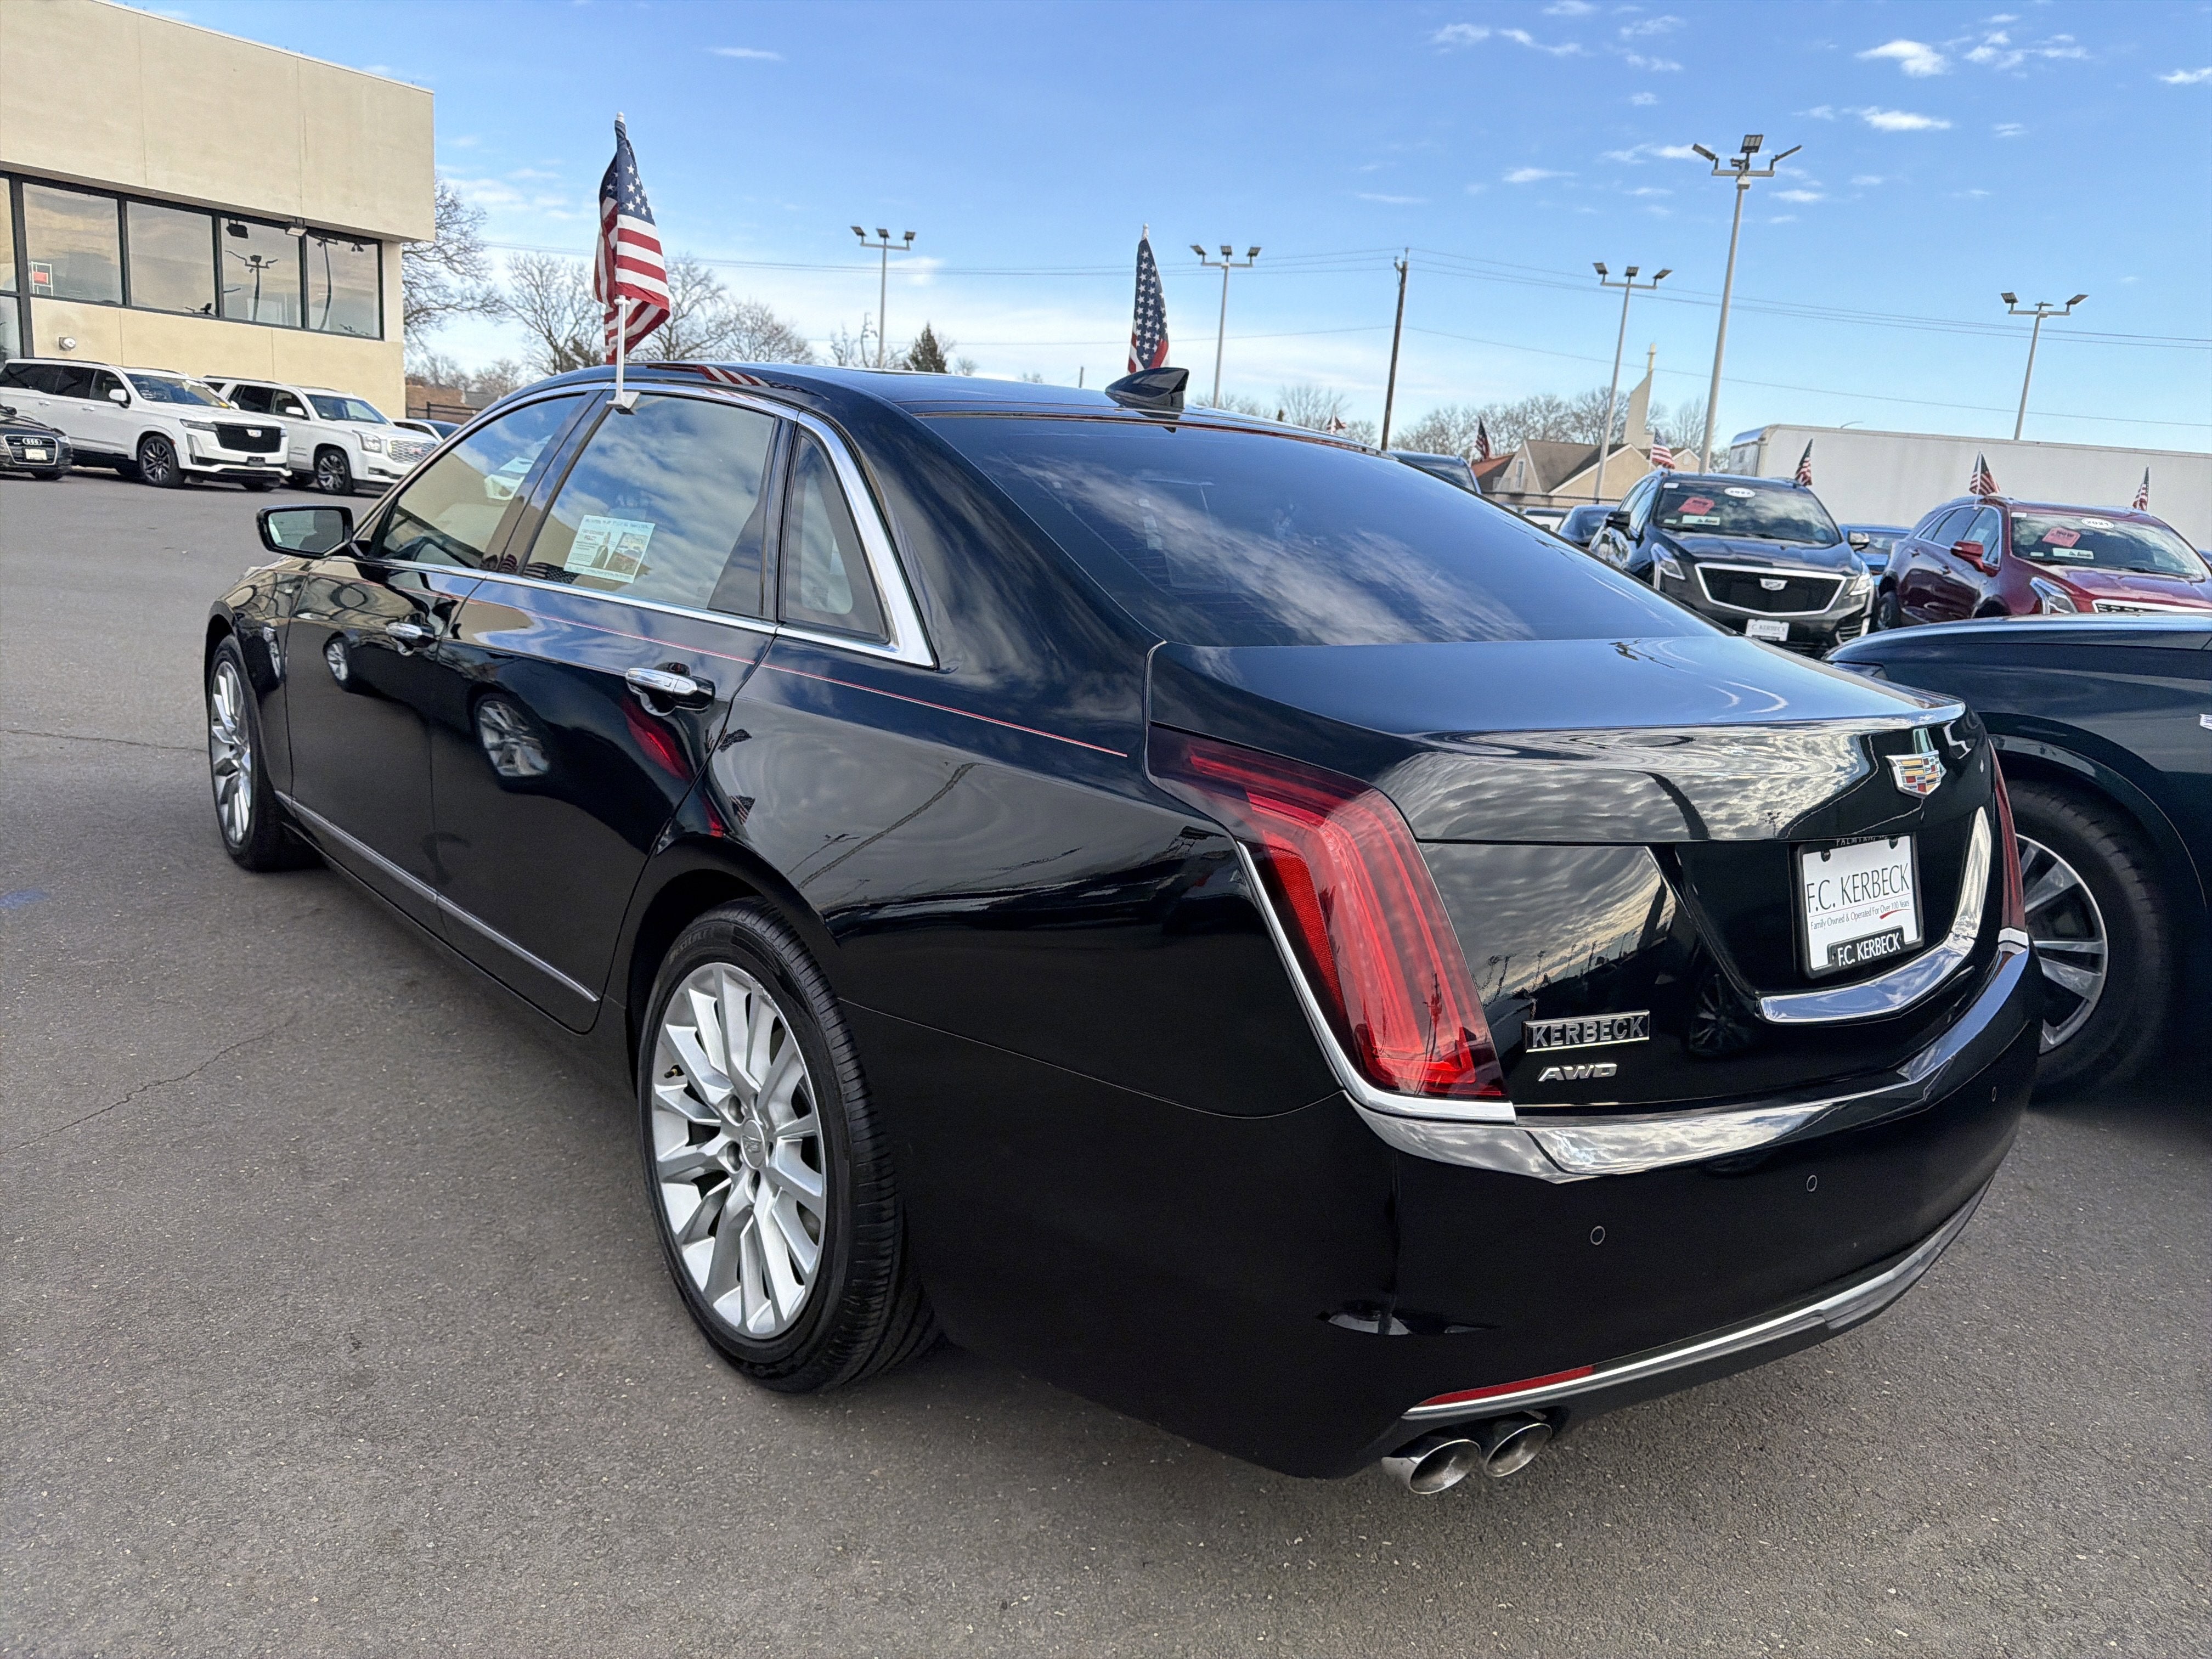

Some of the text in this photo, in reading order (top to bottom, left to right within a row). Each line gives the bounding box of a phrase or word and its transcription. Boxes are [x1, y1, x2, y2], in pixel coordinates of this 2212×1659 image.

[1806, 862, 1910, 913] F.C. KERBECK
[1810, 918, 1826, 930] Family
[1827, 914, 1844, 927] Owned
[1846, 913, 1849, 922] &
[1850, 907, 1871, 922] Operated
[1880, 904, 1891, 913] Over
[1899, 900, 1910, 908] Years
[1837, 932, 1900, 967] F.C. KERBECK
[1532, 1015, 1644, 1048] KERBECK
[1538, 1062, 1618, 1082] AWD
